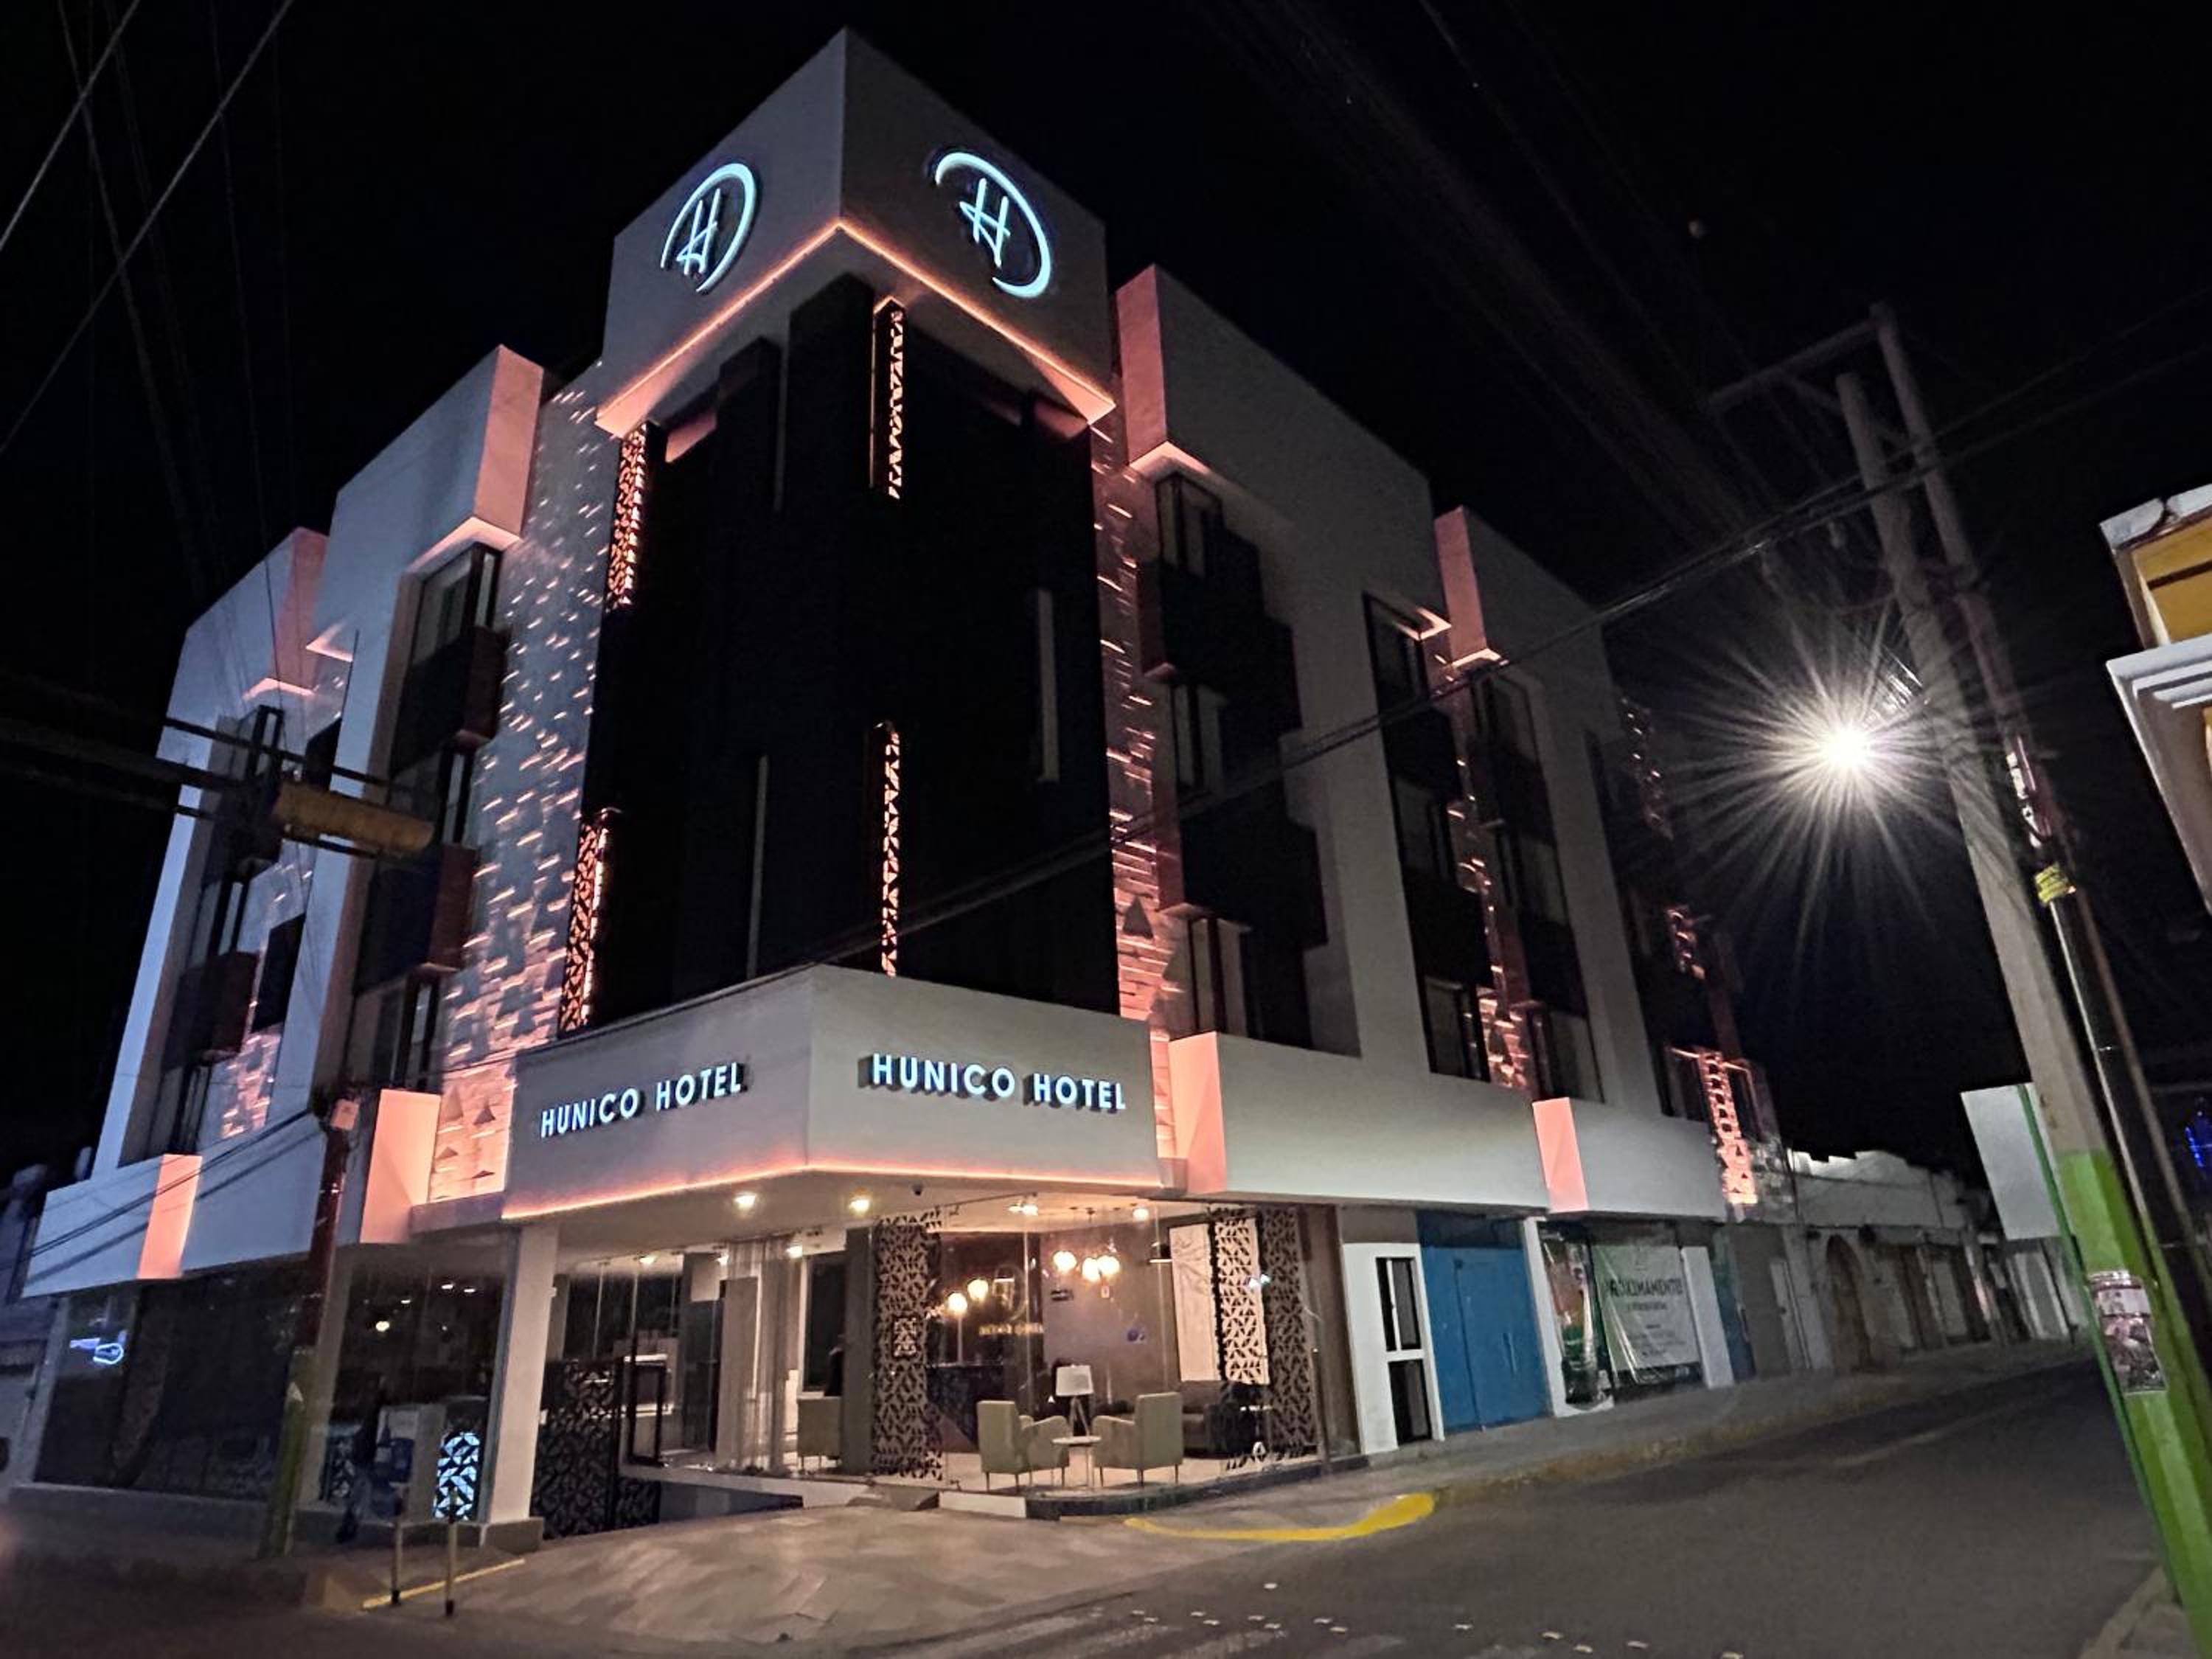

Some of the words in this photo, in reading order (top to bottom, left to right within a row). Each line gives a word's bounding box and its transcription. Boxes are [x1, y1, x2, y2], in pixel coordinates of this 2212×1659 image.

[540, 1088, 639, 1138] HUNICO
[655, 1061, 741, 1112] HOTEL
[872, 1052, 1015, 1098] HUNICO
[1034, 1073, 1126, 1110] HOTEL
